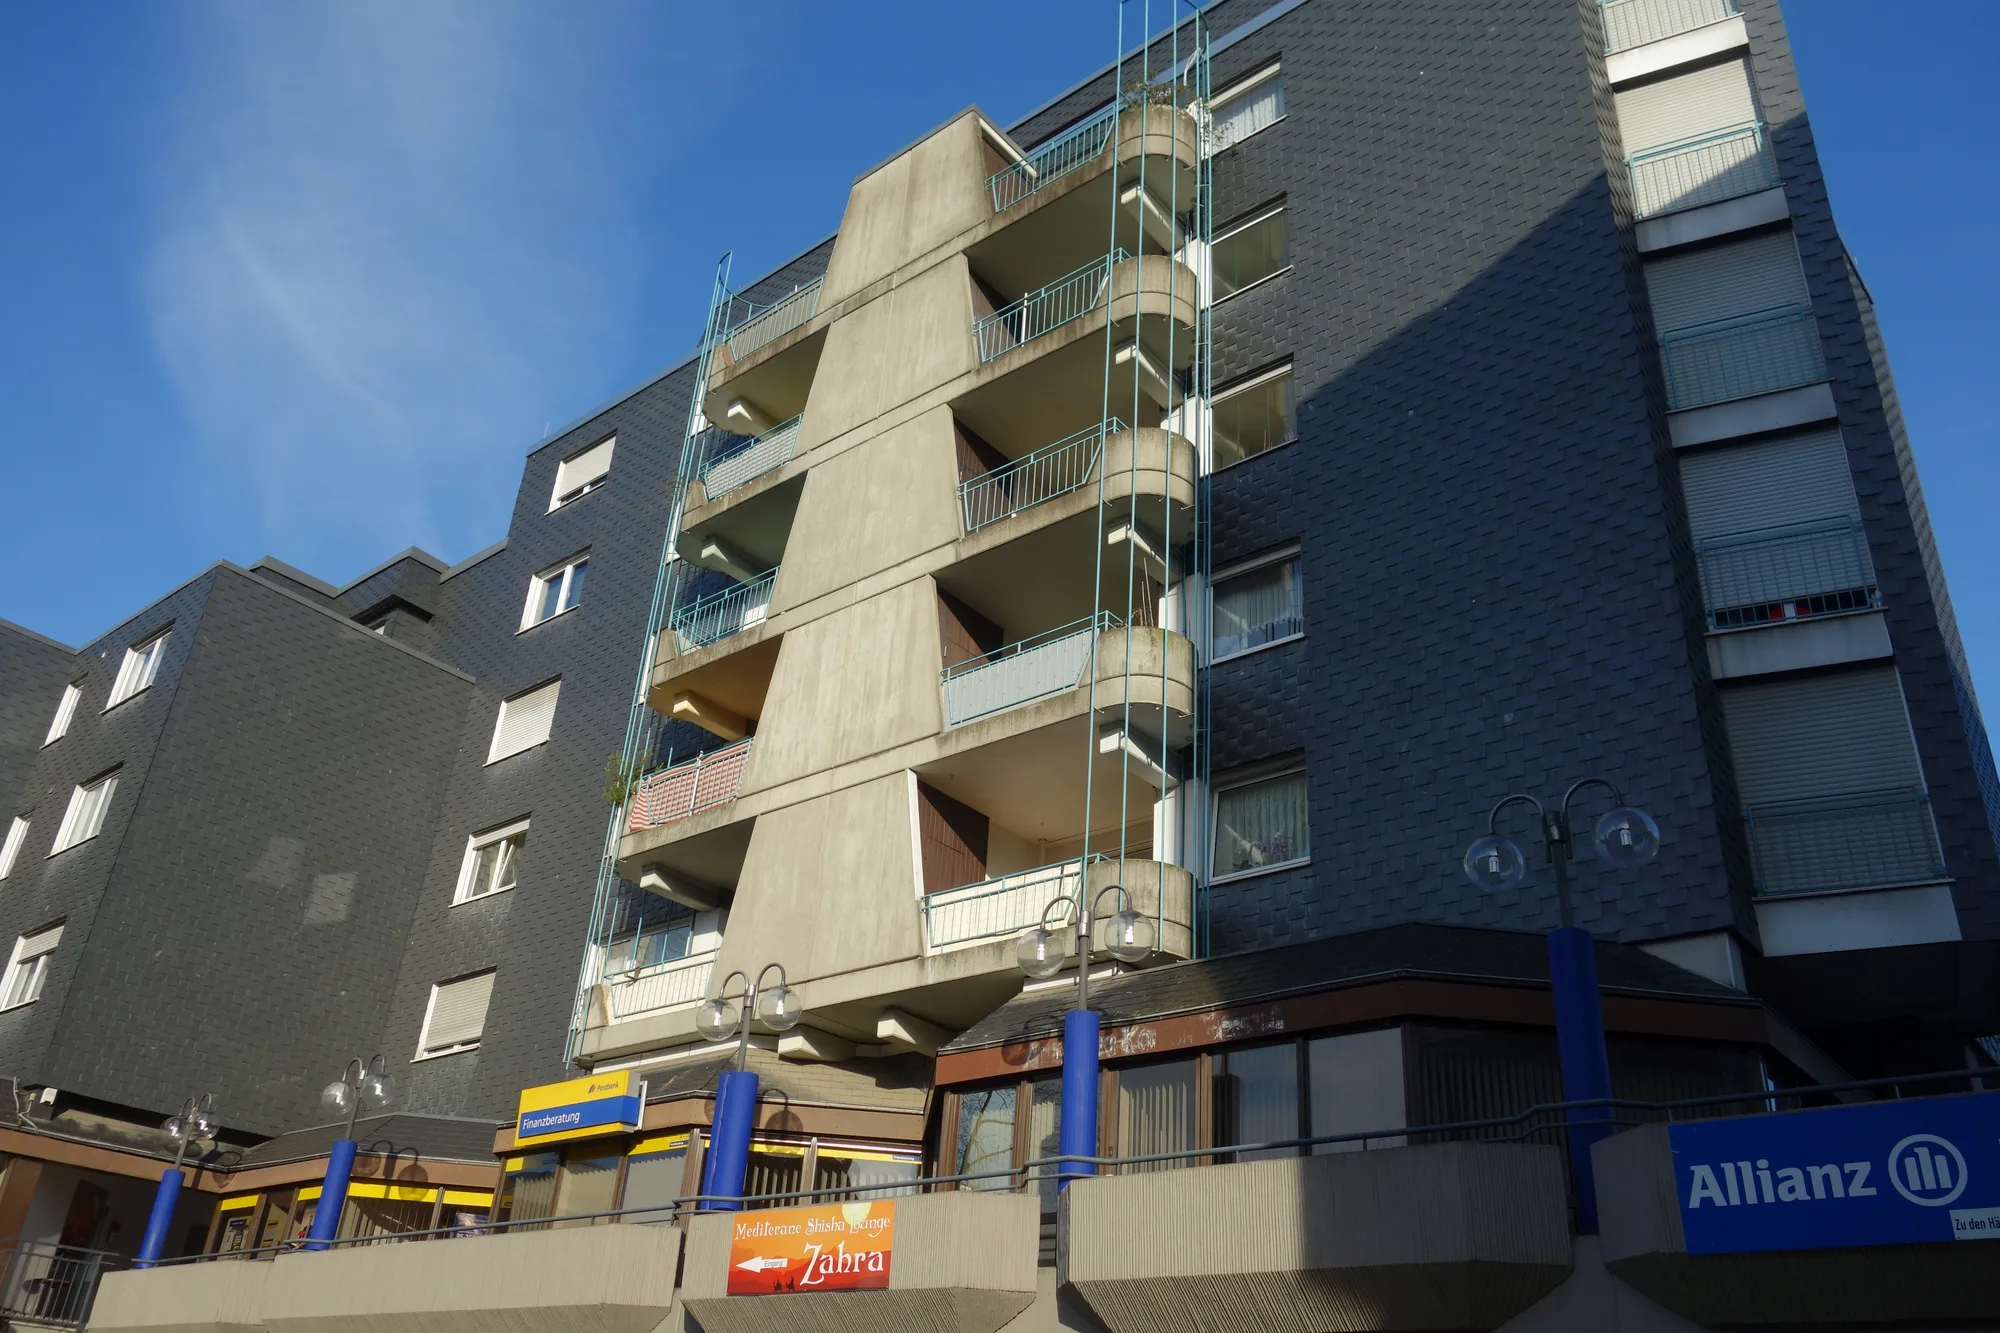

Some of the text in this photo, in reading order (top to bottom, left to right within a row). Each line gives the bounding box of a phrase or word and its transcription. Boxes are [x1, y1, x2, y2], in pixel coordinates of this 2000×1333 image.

[597, 1081, 619, 1092] Postbank
[523, 1112, 580, 1130] Finanzberatung
[1688, 1157, 1877, 1208] Allianz
[735, 1213, 891, 1240] Mediterane Shisha Lounge
[1954, 1218, 1966, 1231] Zu
[1969, 1218, 1986, 1230] den
[764, 1260, 784, 1268] Eingang
[799, 1240, 884, 1286] Zahra
